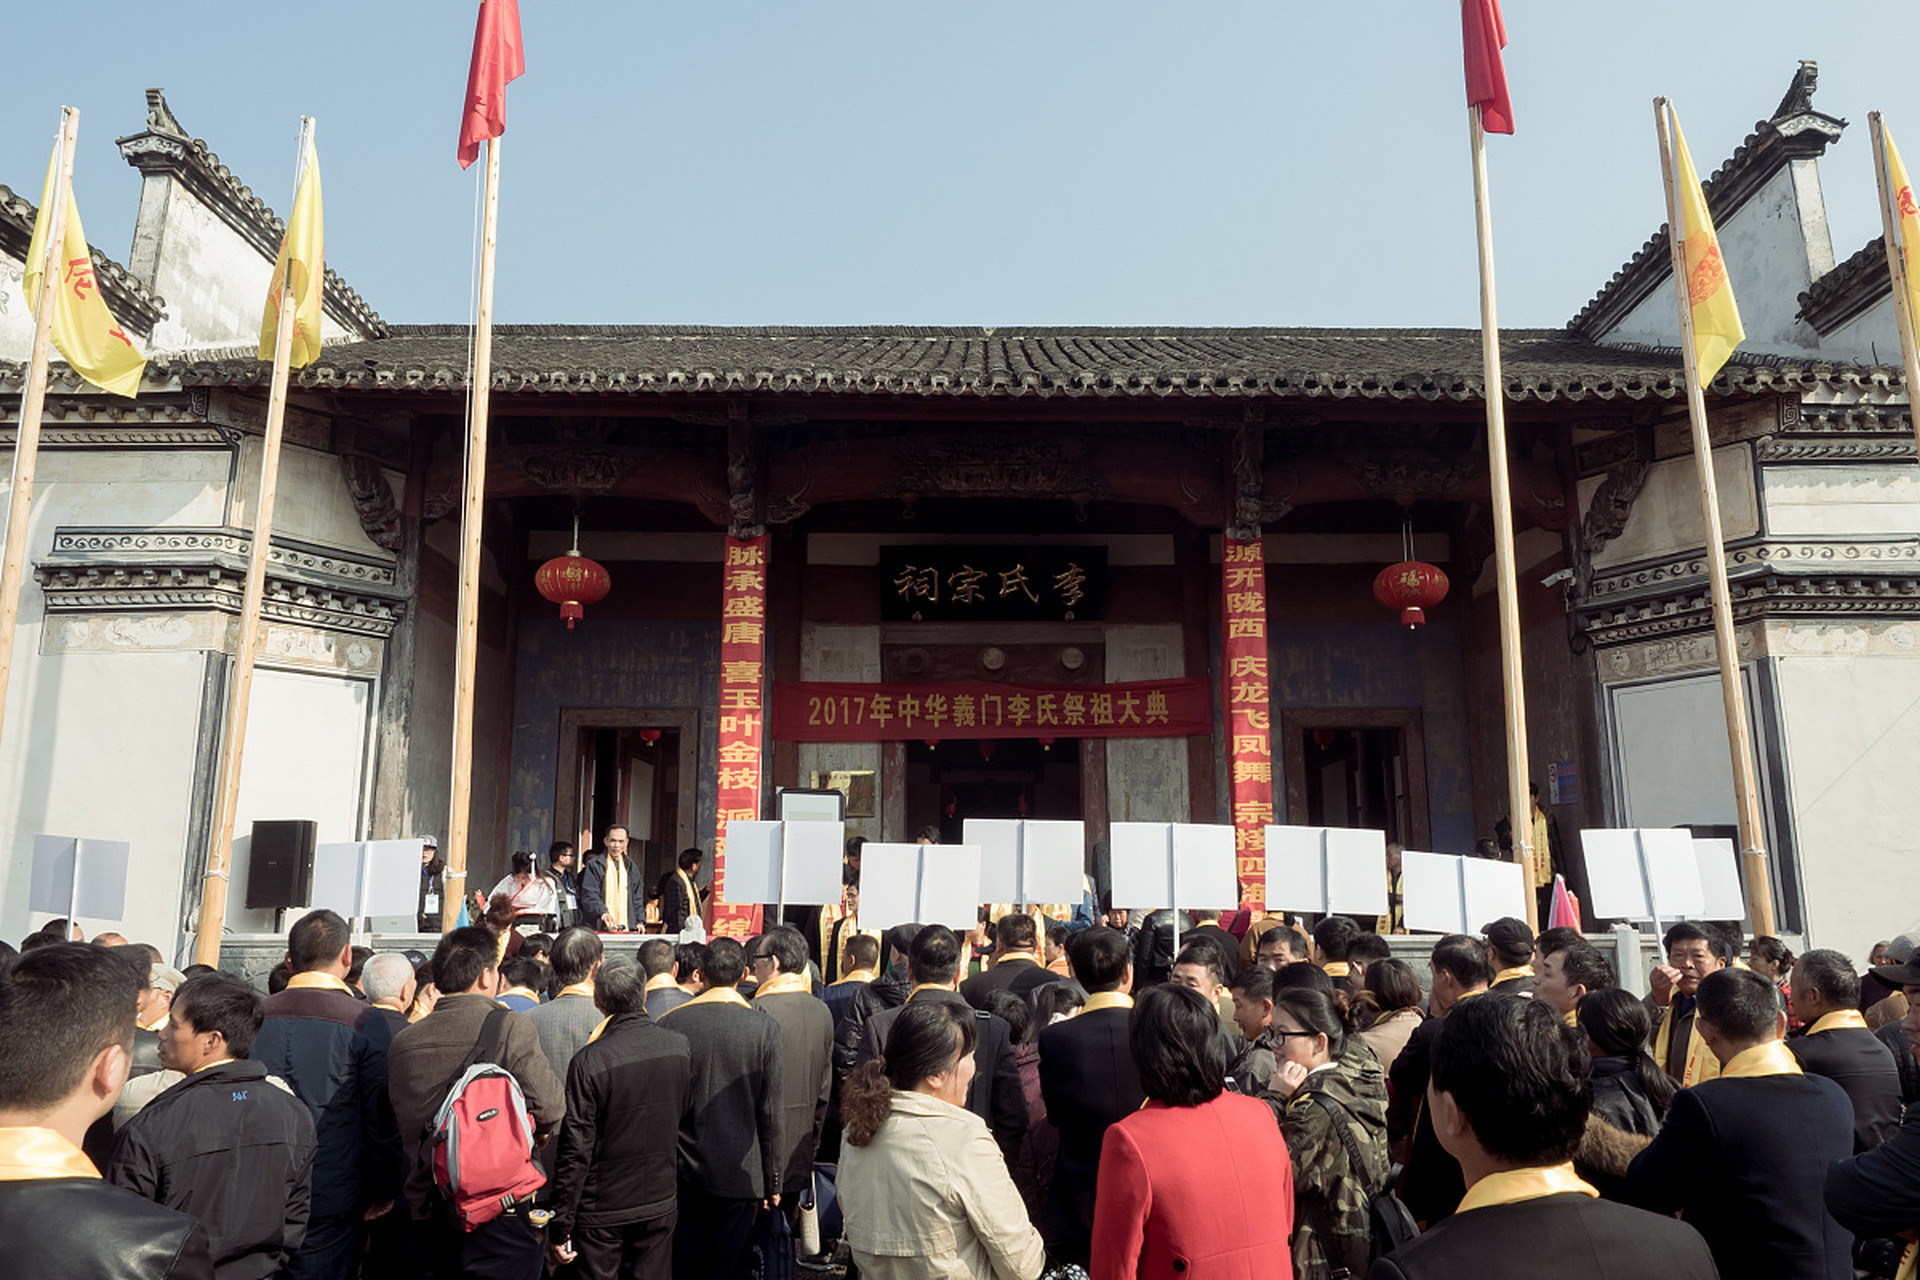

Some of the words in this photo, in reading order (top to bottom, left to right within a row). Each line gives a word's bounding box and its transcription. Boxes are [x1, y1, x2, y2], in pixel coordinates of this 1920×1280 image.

[723, 545, 764, 644] 脉承盛唐
[894, 562, 1086, 606] 李氏宗祠
[1225, 543, 1266, 639] 源开陇西
[718, 660, 762, 790] 喜玉叶金枝
[808, 690, 1170, 729] 2017年中华義门李氏祭祖大典
[1230, 655, 1272, 784] 庆龙飞凤舞
